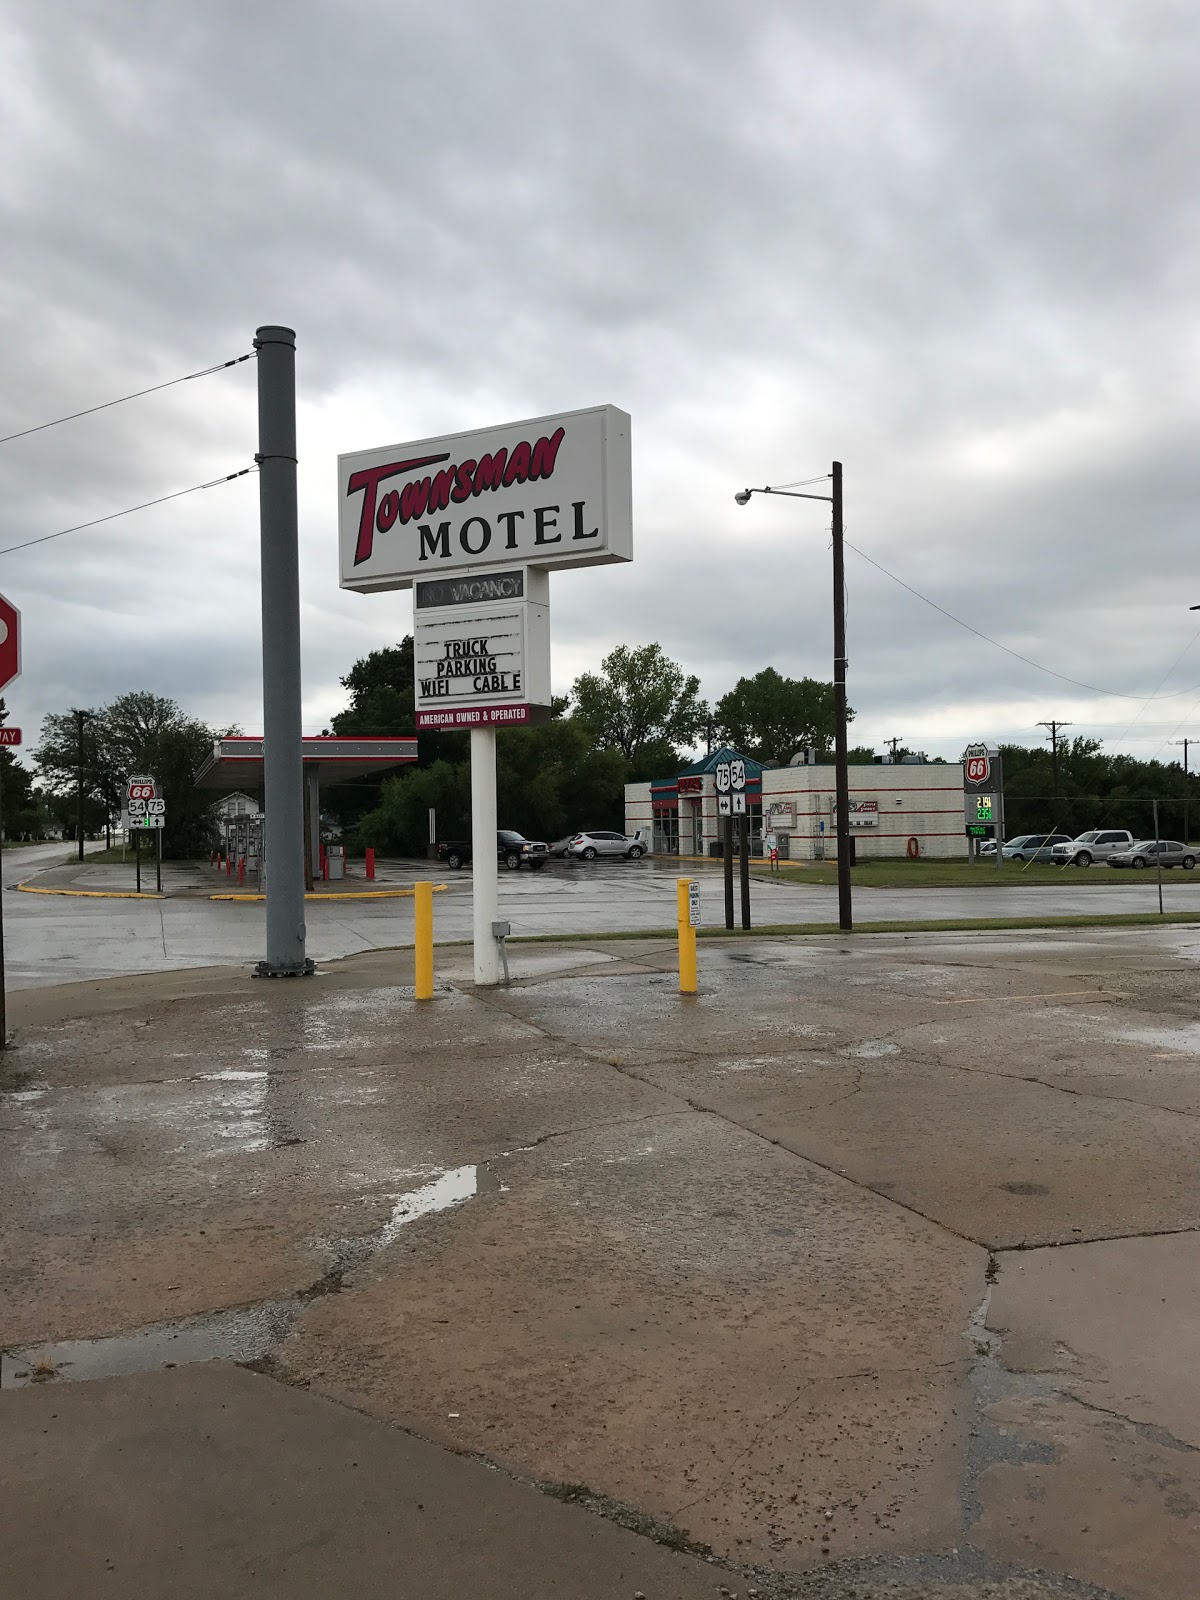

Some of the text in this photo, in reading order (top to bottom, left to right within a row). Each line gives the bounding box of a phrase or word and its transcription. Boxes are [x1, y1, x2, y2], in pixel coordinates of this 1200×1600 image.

[418, 501, 599, 560] MOTEL
[450, 577, 521, 601] VACANCY
[444, 640, 489, 658] TRUCK
[437, 657, 497, 677] PARKING
[421, 679, 450, 696] WIFI
[419, 708, 526, 725] AMERICAN OWNED & OPERATED
[0, 731, 16, 742] AY
[732, 765, 744, 783] 54
[970, 760, 984, 776] 66
[717, 769, 729, 786] 75
[133, 787, 151, 797] 66
[130, 802, 144, 812] 54
[149, 802, 163, 811] 75
